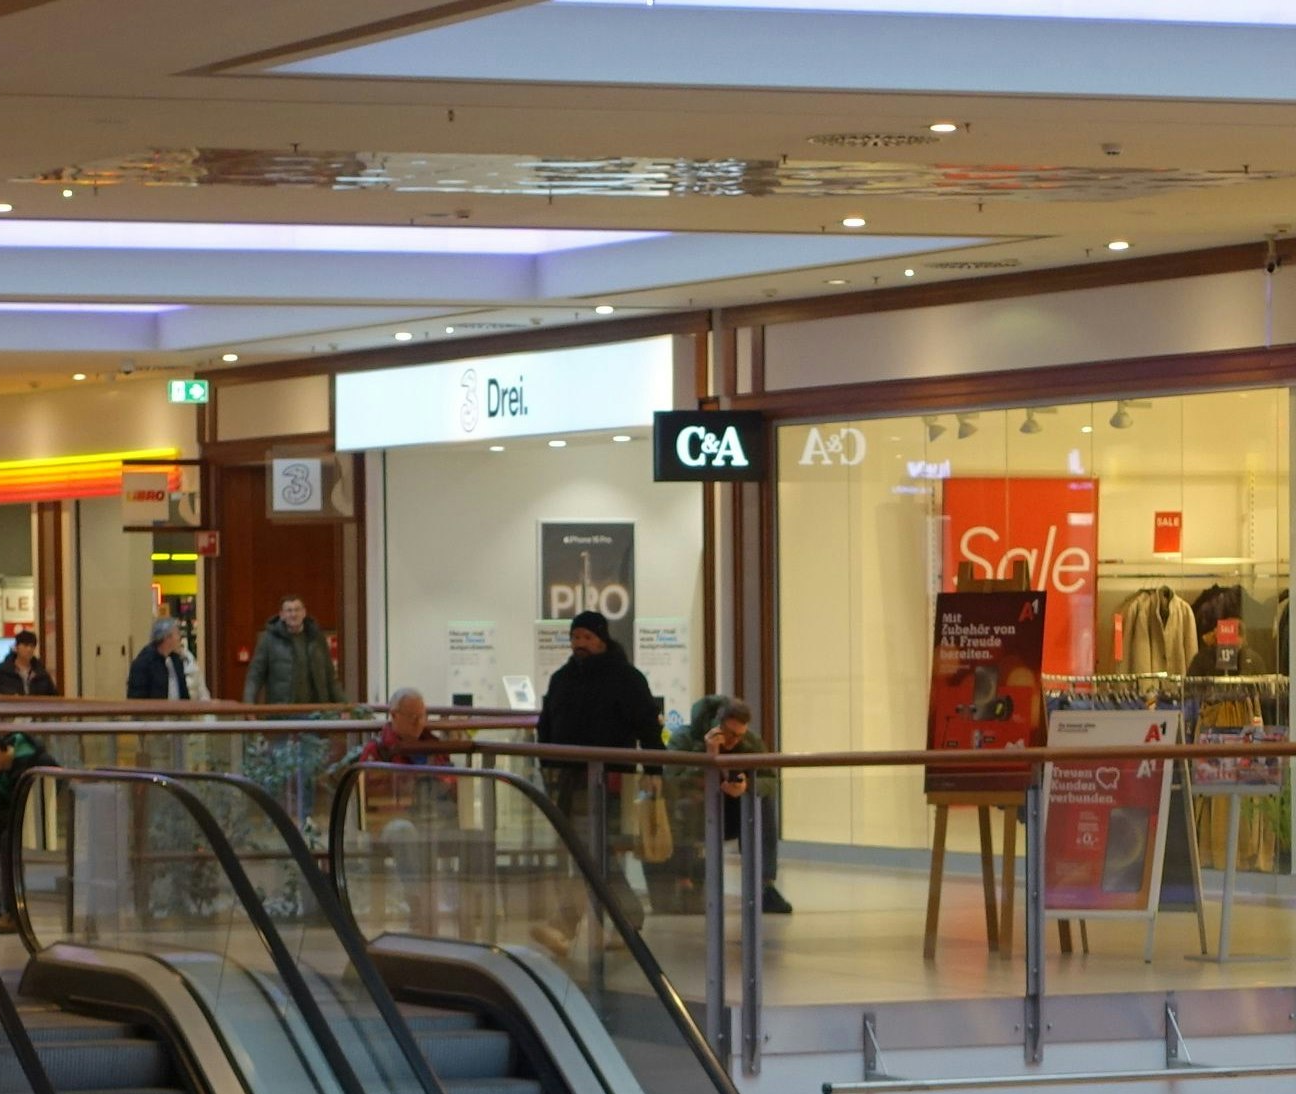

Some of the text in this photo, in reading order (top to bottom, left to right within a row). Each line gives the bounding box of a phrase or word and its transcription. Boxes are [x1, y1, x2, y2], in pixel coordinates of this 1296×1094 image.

[487, 377, 529, 418] Drei.
[675, 425, 749, 468] C&A
[282, 463, 313, 506] 3
[1157, 516, 1181, 528] SALE
[1018, 599, 1040, 622] A1
[942, 613, 962, 623] Mit
[941, 624, 1016, 635] Zubehör von
[941, 636, 1001, 647] A1 Freude
[940, 649, 993, 659] bereiten.
[1145, 721, 1167, 743] A1
[1050, 779, 1097, 791] Kunden
